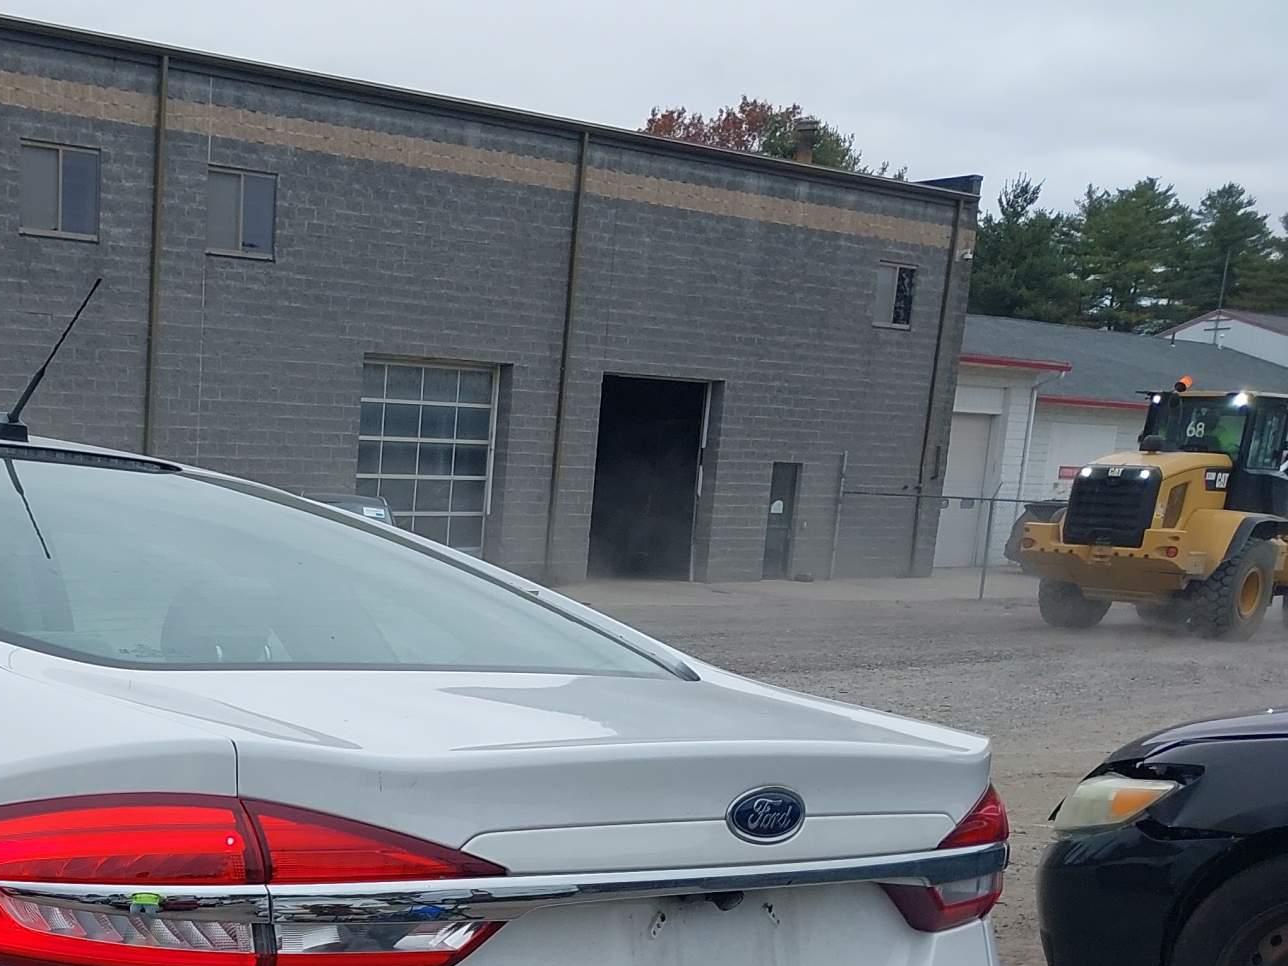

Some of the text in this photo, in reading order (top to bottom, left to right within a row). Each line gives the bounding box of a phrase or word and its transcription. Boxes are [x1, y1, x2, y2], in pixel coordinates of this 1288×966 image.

[1186, 421, 1205, 438] 68
[1108, 467, 1124, 476] CAT
[1215, 472, 1229, 488] CAT
[748, 798, 793, 829] Ford
